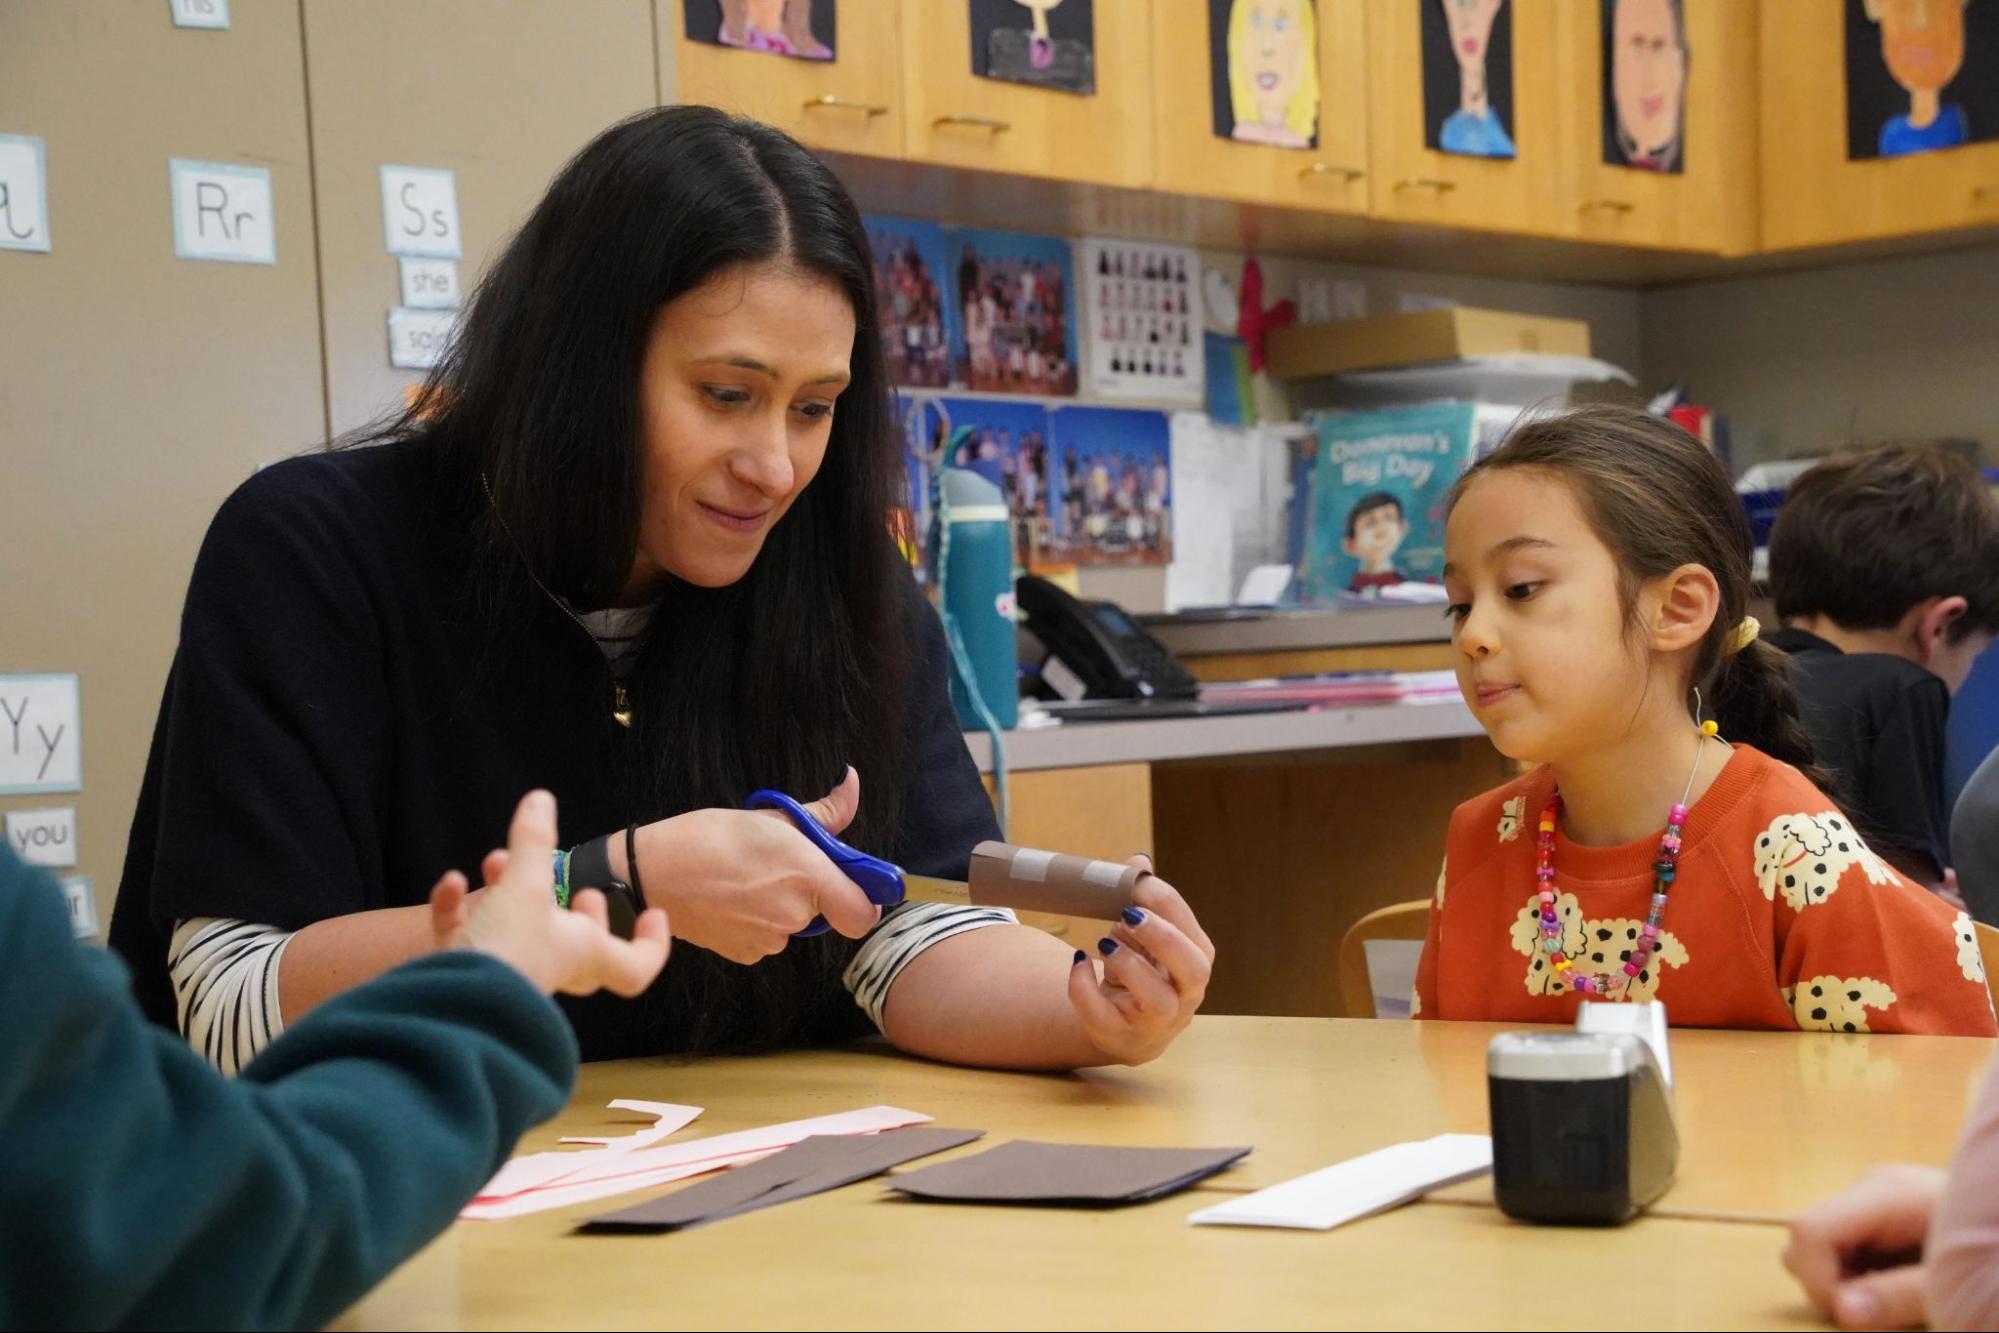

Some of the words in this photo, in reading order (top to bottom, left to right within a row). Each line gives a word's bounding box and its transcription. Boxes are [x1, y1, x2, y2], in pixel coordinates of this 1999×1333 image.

[197, 181, 254, 240] Rr
[400, 182, 449, 238] Ss
[412, 267, 450, 293] she
[1342, 460, 1381, 486] Big
[1386, 453, 1435, 489] Day
[0, 697, 65, 780] Yy
[16, 824, 68, 852] you
